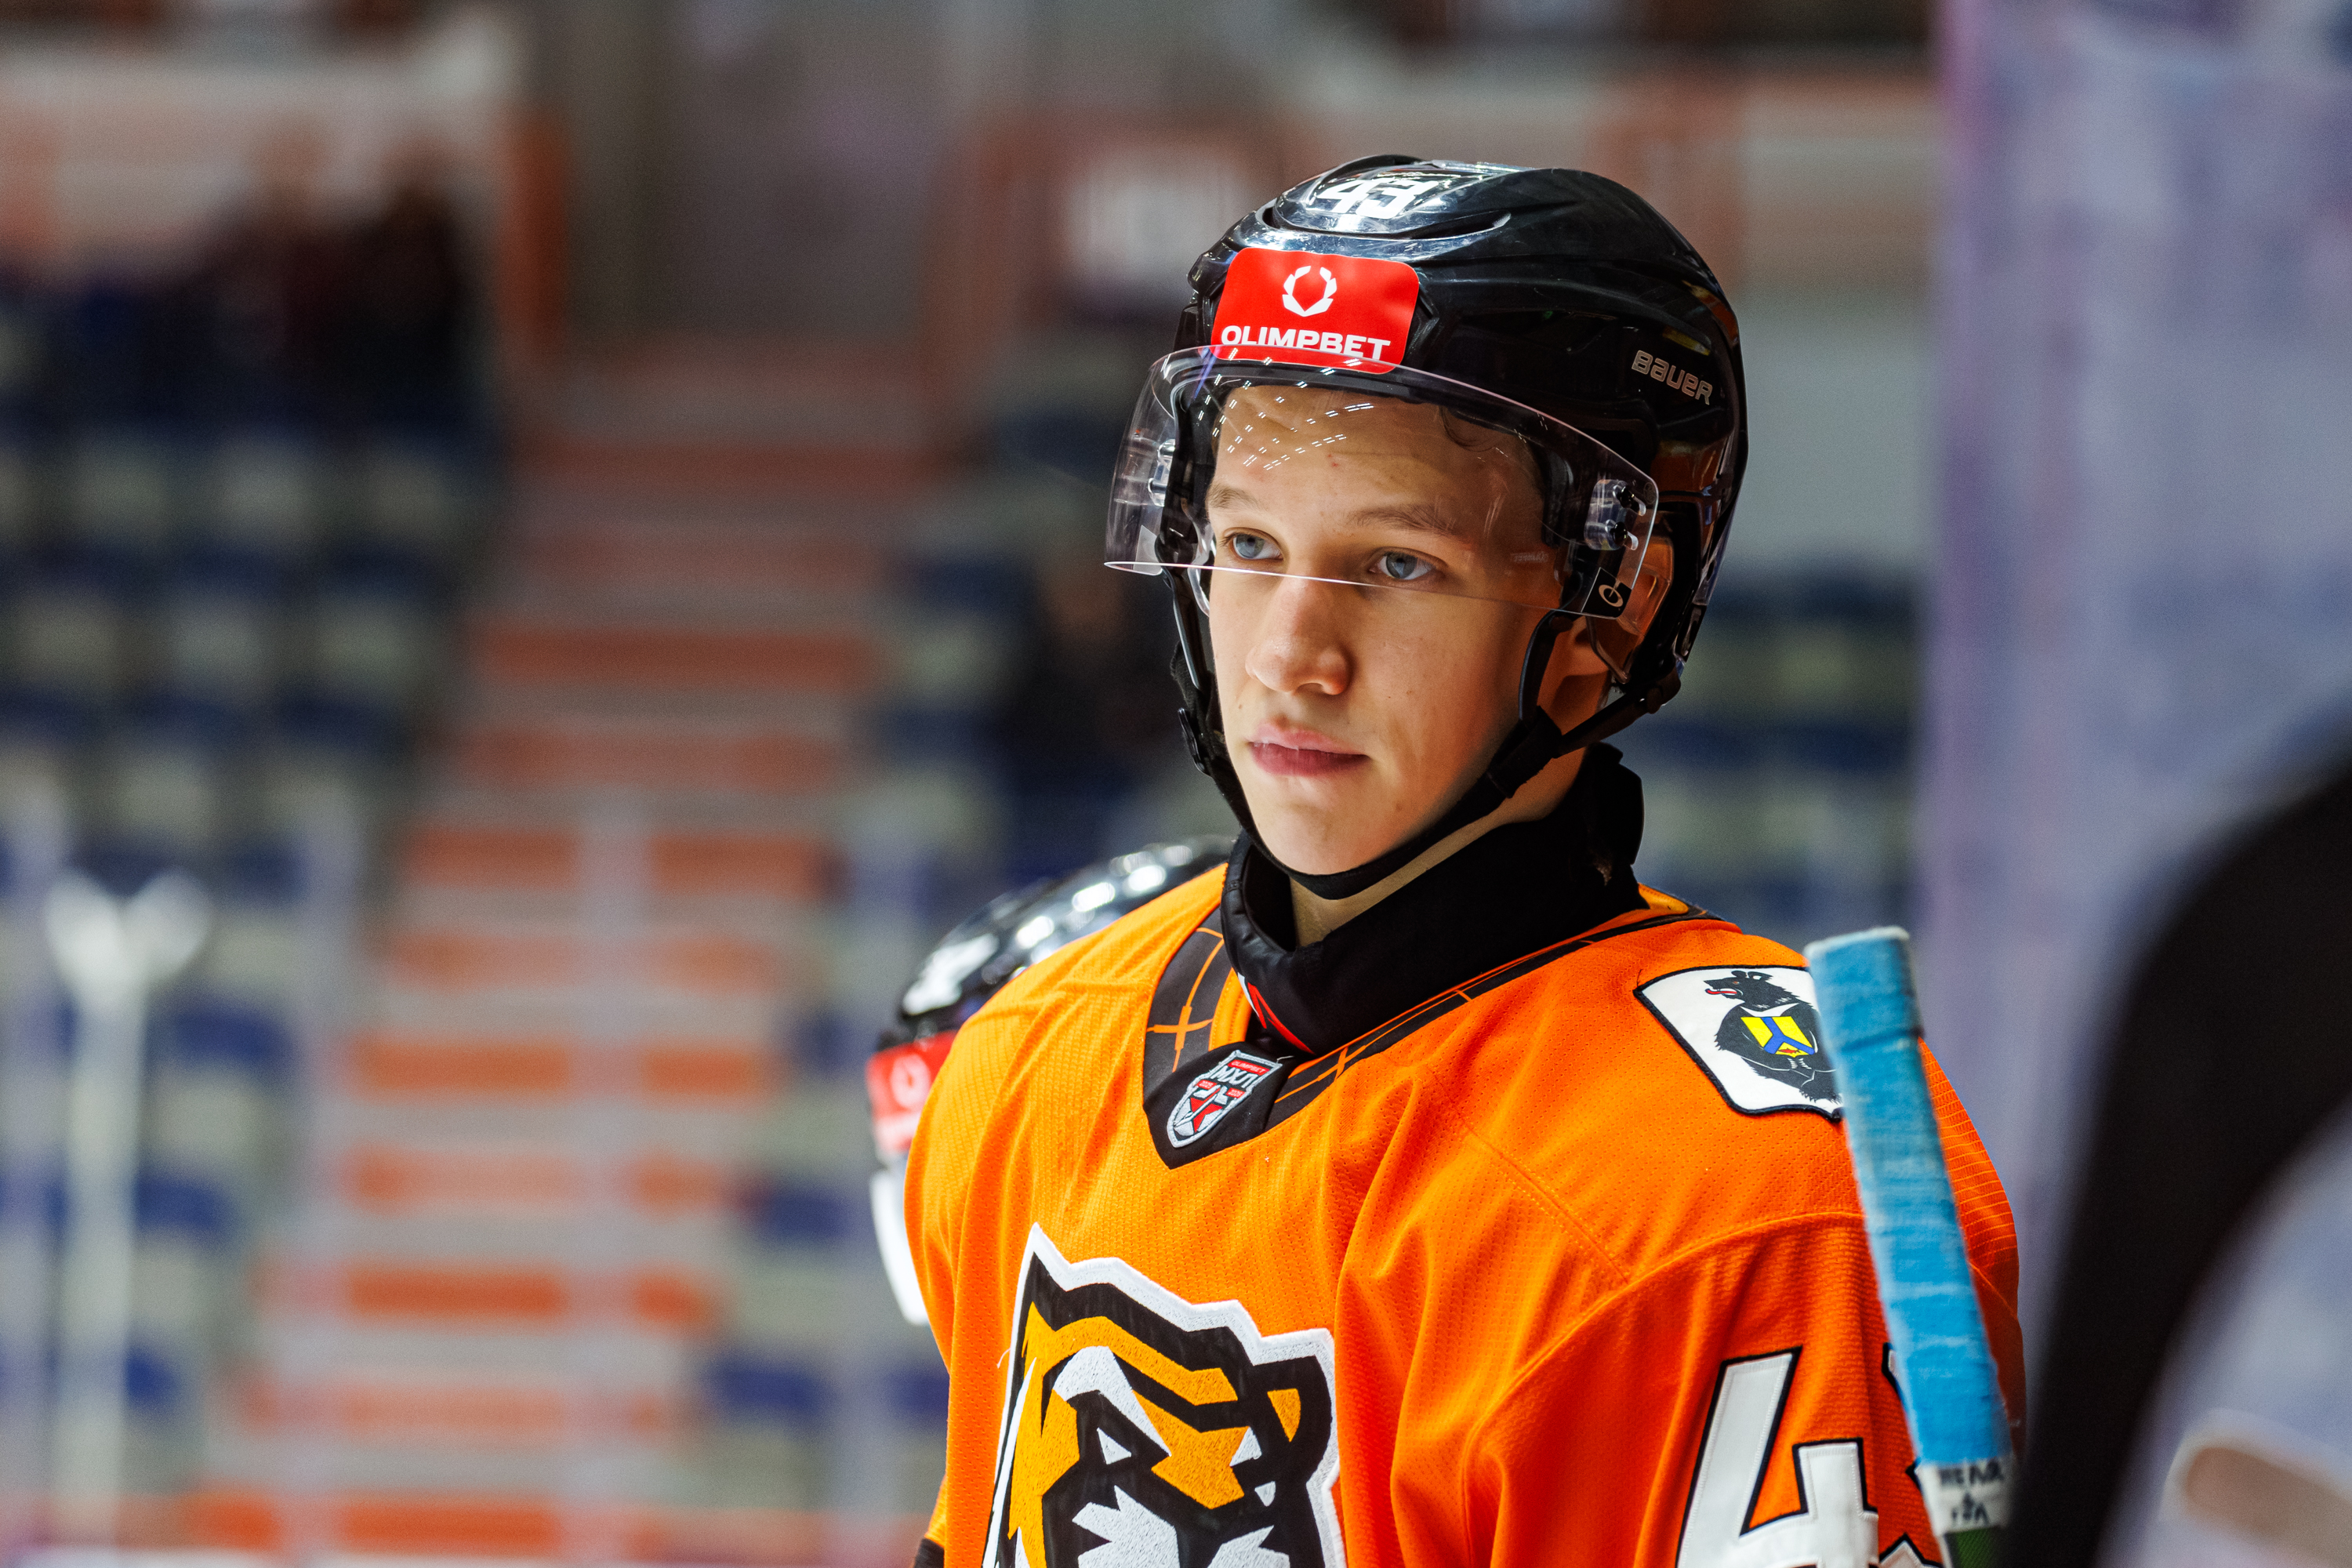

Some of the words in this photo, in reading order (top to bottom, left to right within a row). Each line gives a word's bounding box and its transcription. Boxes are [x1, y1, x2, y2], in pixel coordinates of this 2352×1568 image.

[1316, 179, 1439, 220] 43
[1221, 325, 1392, 361] OLIMPBET
[1231, 1061, 1266, 1073] OLIMPBET
